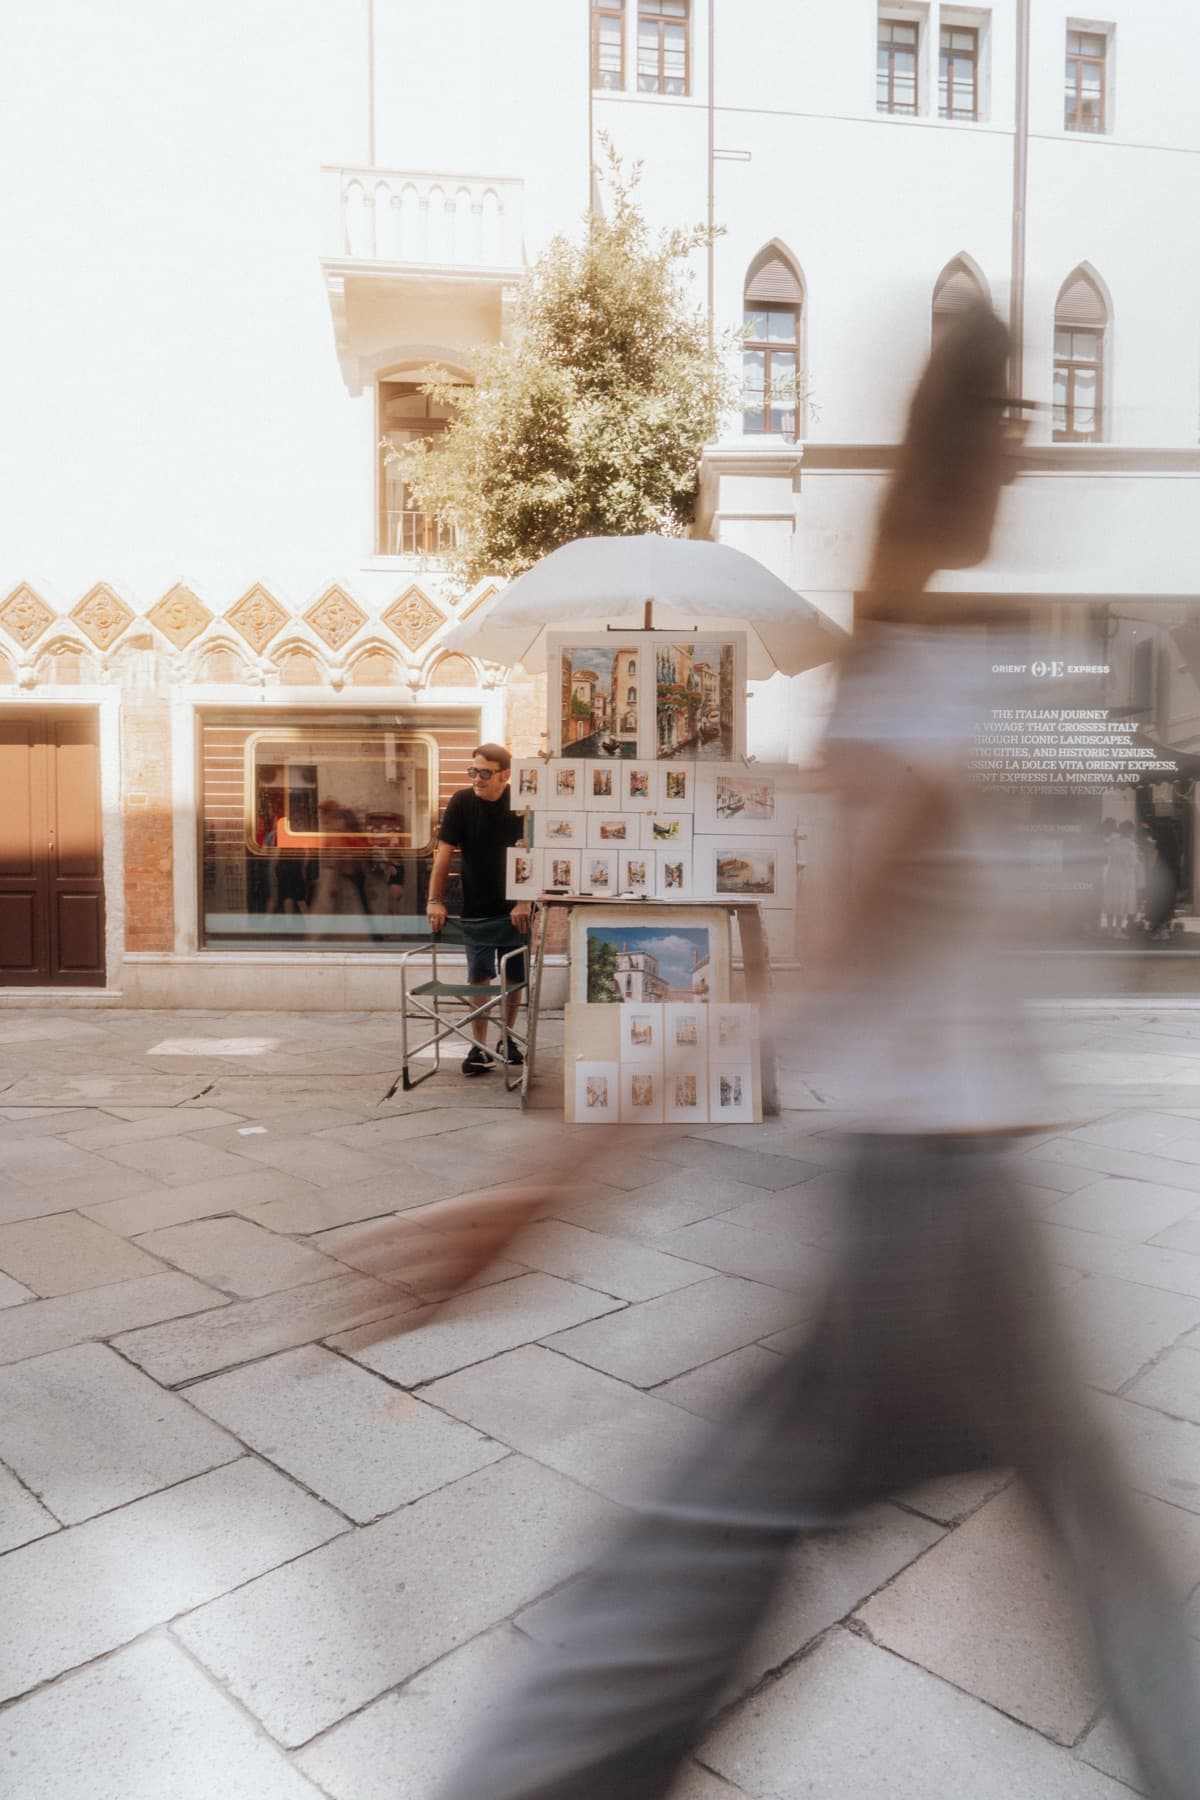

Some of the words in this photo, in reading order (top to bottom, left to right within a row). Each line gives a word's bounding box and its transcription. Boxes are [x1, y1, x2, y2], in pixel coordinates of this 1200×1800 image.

[991, 664, 1027, 672] ORIENT
[1067, 665, 1110, 673] EXPRESS
[992, 709, 1014, 719] THE
[1015, 710, 1059, 719] ITALIAN
[1060, 710, 1109, 720] JOURNEY
[984, 722, 1024, 732] VOYAGE
[1026, 722, 1056, 732] THAT
[1057, 722, 1107, 732] CROSSES
[1108, 722, 1139, 732] ITALY
[1021, 735, 1058, 745] ICONIC
[1060, 736, 1133, 746] LANDSCAPES,
[993, 748, 1031, 758] CITIES,
[1033, 748, 1057, 758] AND
[1058, 748, 1110, 758] HISTORIC
[1111, 748, 1157, 759] VENUES,
[1005, 760, 1020, 770] LA
[1022, 760, 1057, 770] DOLCE
[1059, 760, 1084, 770] VITA
[1086, 761, 1126, 770] ORIENT
[1128, 761, 1179, 772] EXPRESS,
[1000, 772, 1048, 782] EXPRESS
[1050, 773, 1064, 782] LA
[1066, 773, 1114, 783] MINERVA
[1116, 773, 1140, 782] AND
